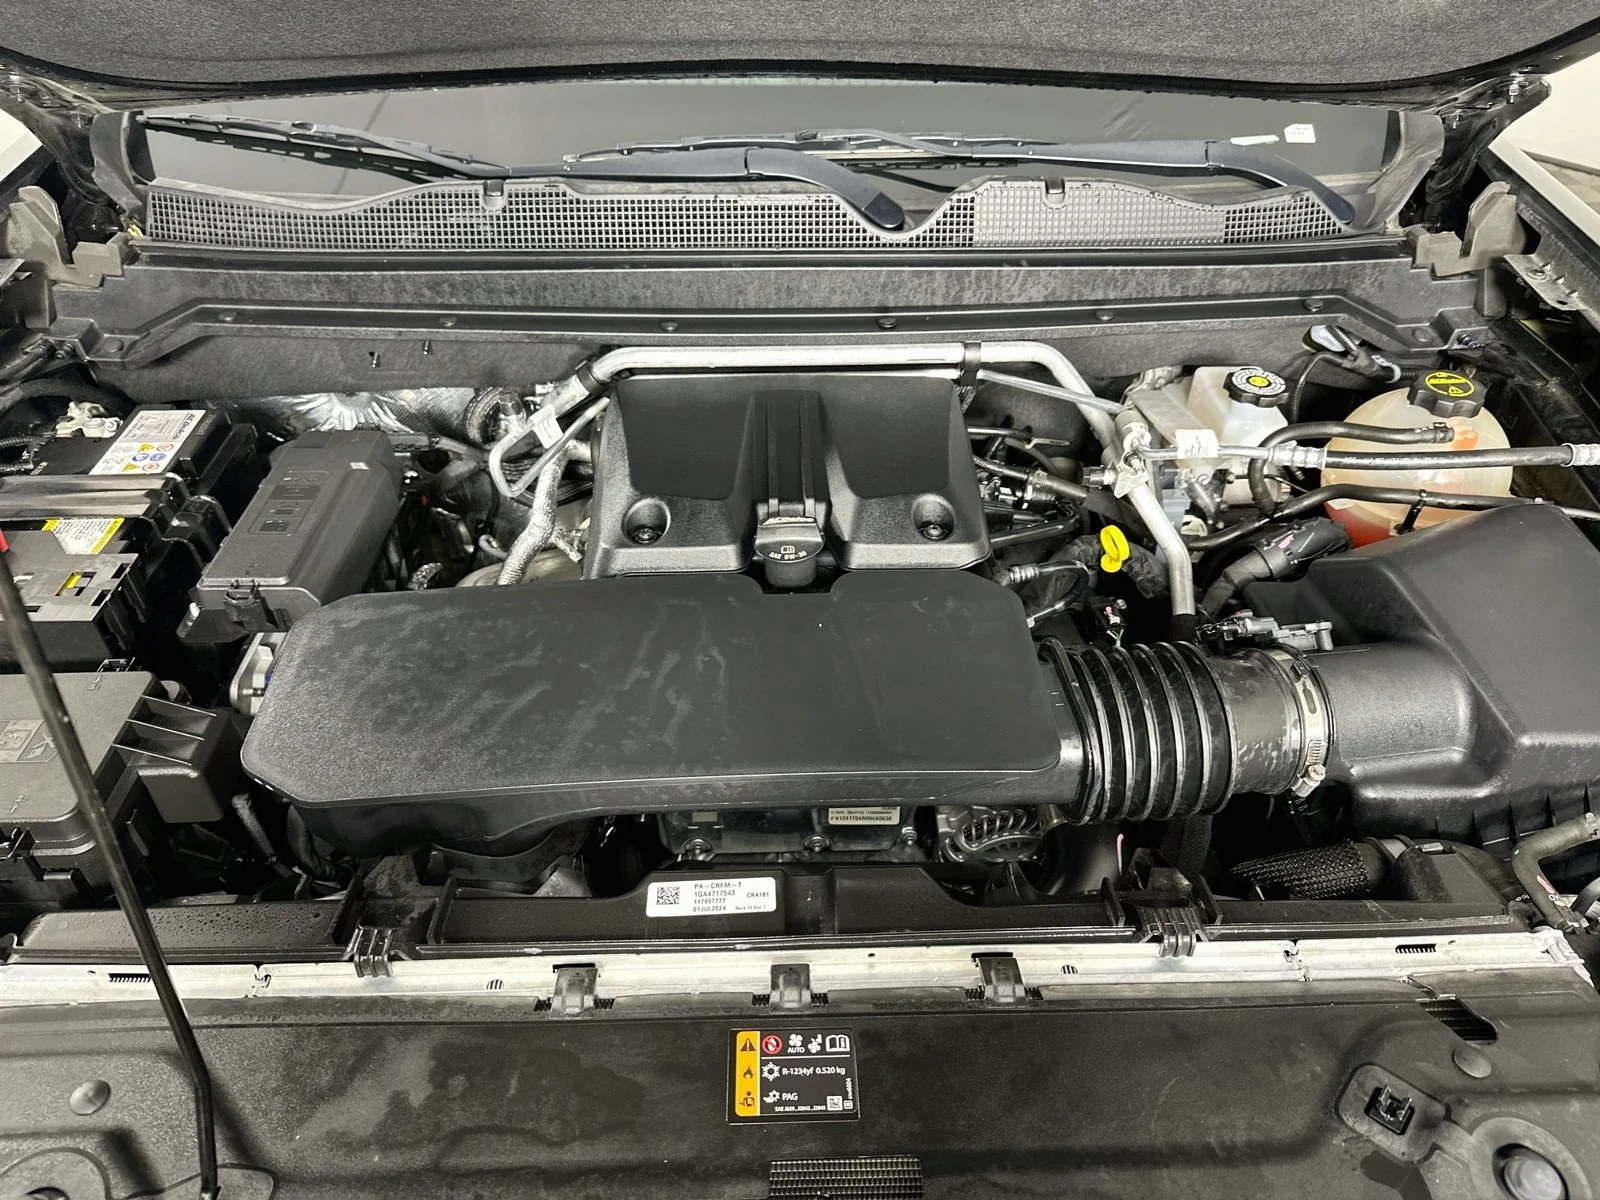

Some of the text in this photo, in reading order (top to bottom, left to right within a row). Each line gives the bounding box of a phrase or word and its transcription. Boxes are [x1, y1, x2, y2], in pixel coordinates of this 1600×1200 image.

[694, 890, 736, 898] 1GA4717543
[692, 905, 727, 913] 01JUL2024
[782, 1066, 846, 1076] R-1234yf 0.520 kg
[781, 1092, 799, 1101] PAG
